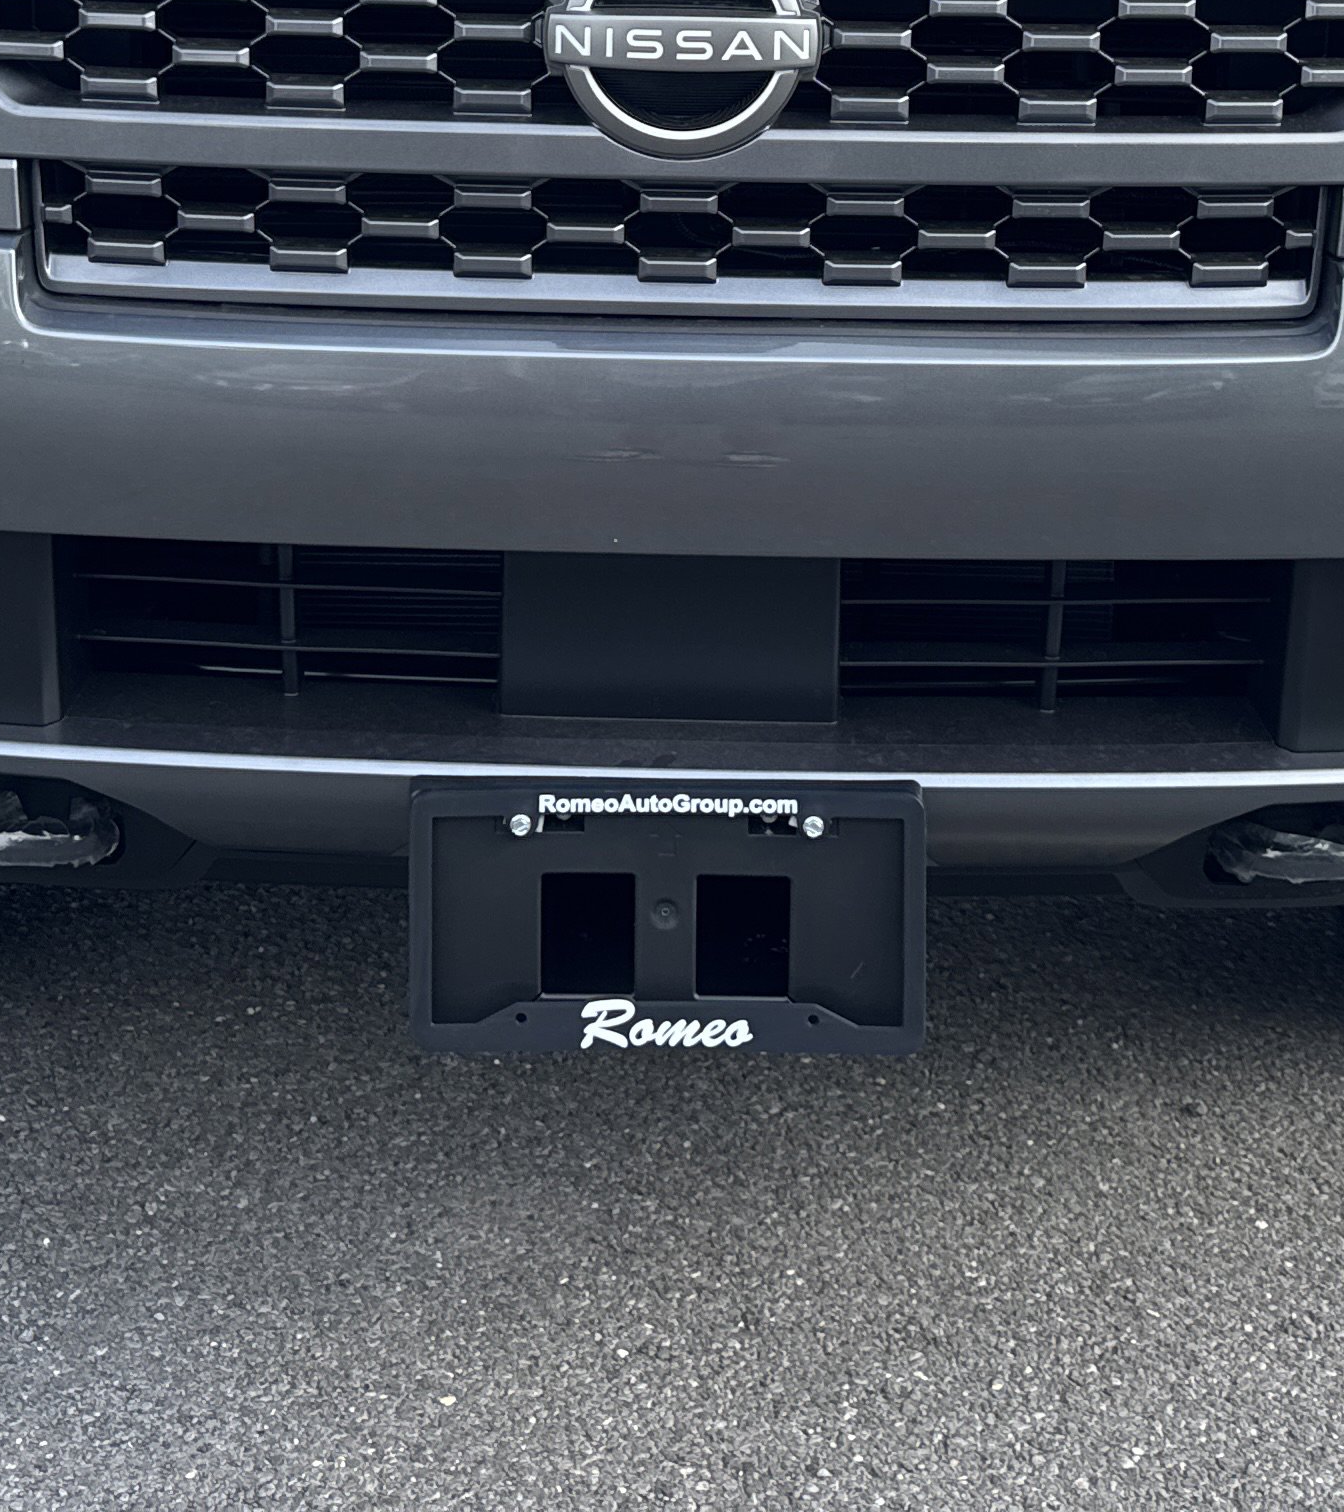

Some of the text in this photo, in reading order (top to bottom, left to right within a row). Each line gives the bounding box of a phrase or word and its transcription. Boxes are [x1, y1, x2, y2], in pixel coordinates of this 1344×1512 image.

[554, 24, 810, 61] NISSAN
[538, 793, 798, 817] RomeoAutoGroup.com
[580, 998, 754, 1050] Romeo
